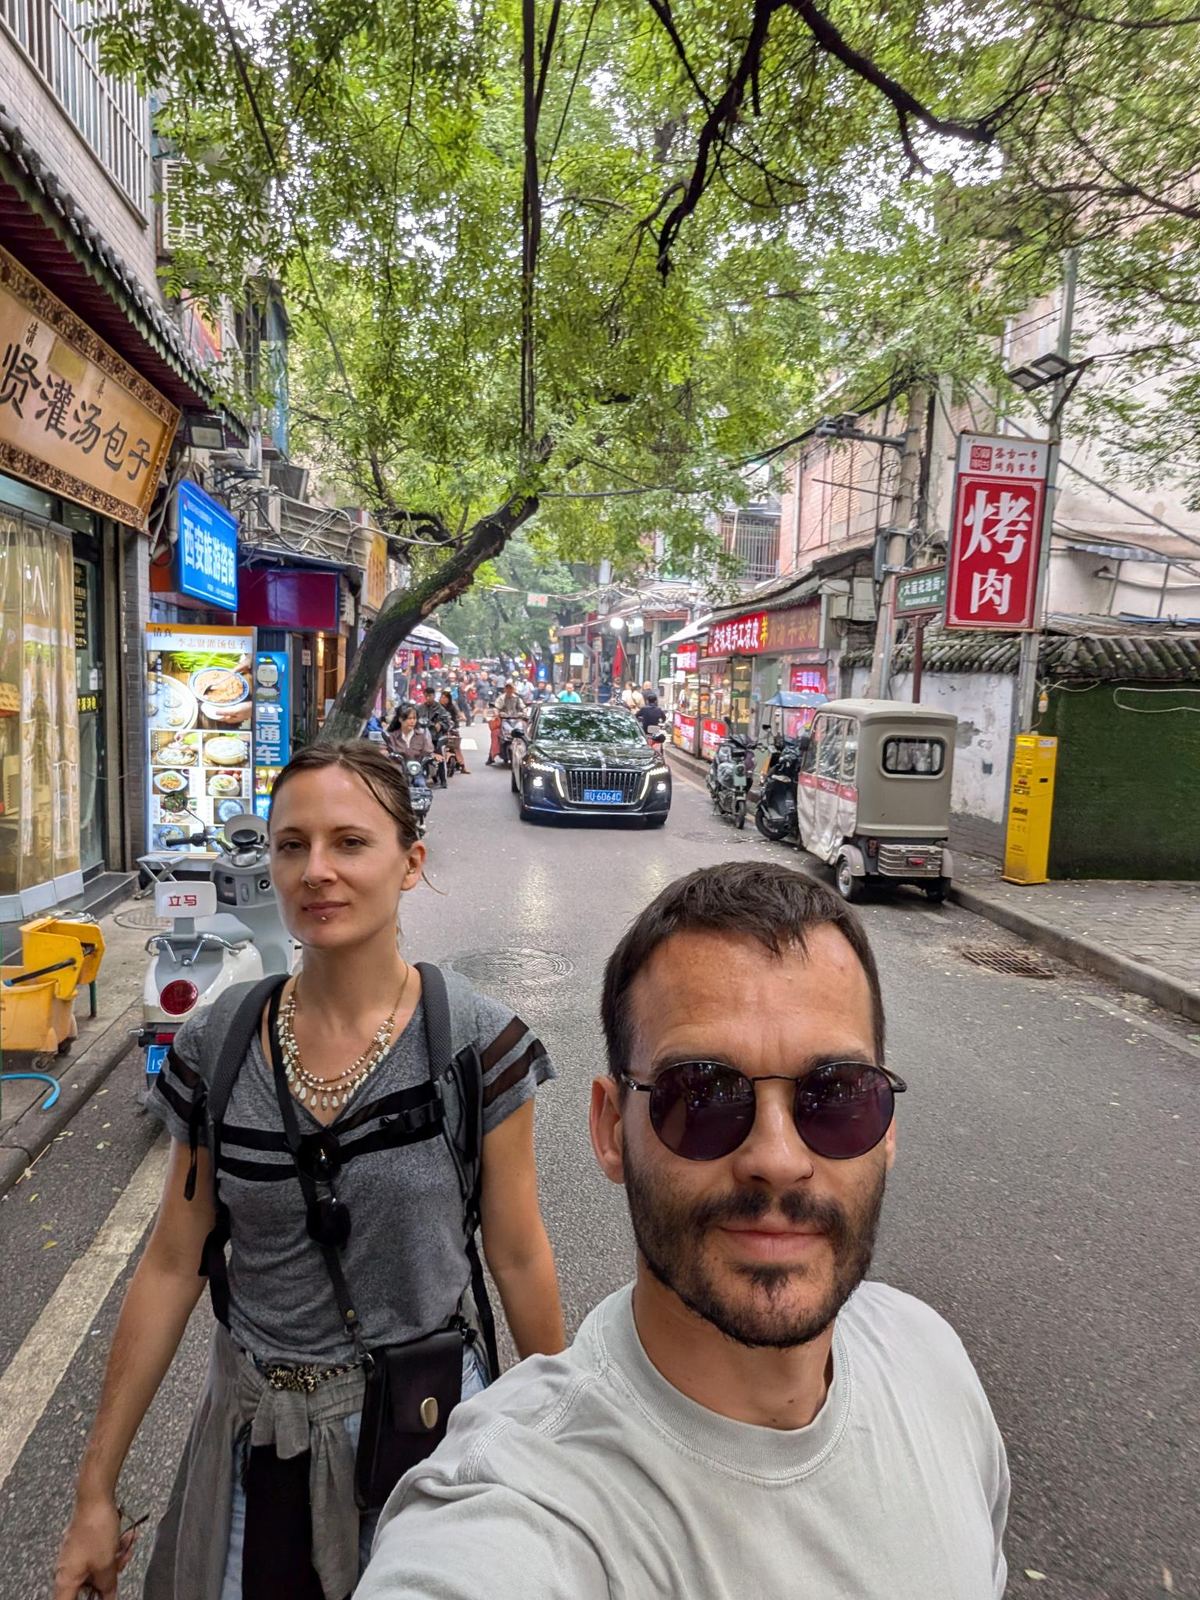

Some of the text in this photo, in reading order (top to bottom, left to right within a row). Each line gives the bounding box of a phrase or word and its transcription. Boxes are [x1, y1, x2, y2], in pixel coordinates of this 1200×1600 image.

[0, 343, 151, 481] 贤灌汤包子
[961, 489, 1032, 615] 烤肉
[255, 702, 281, 765] 直通车
[168, 894, 198, 907] 立马
